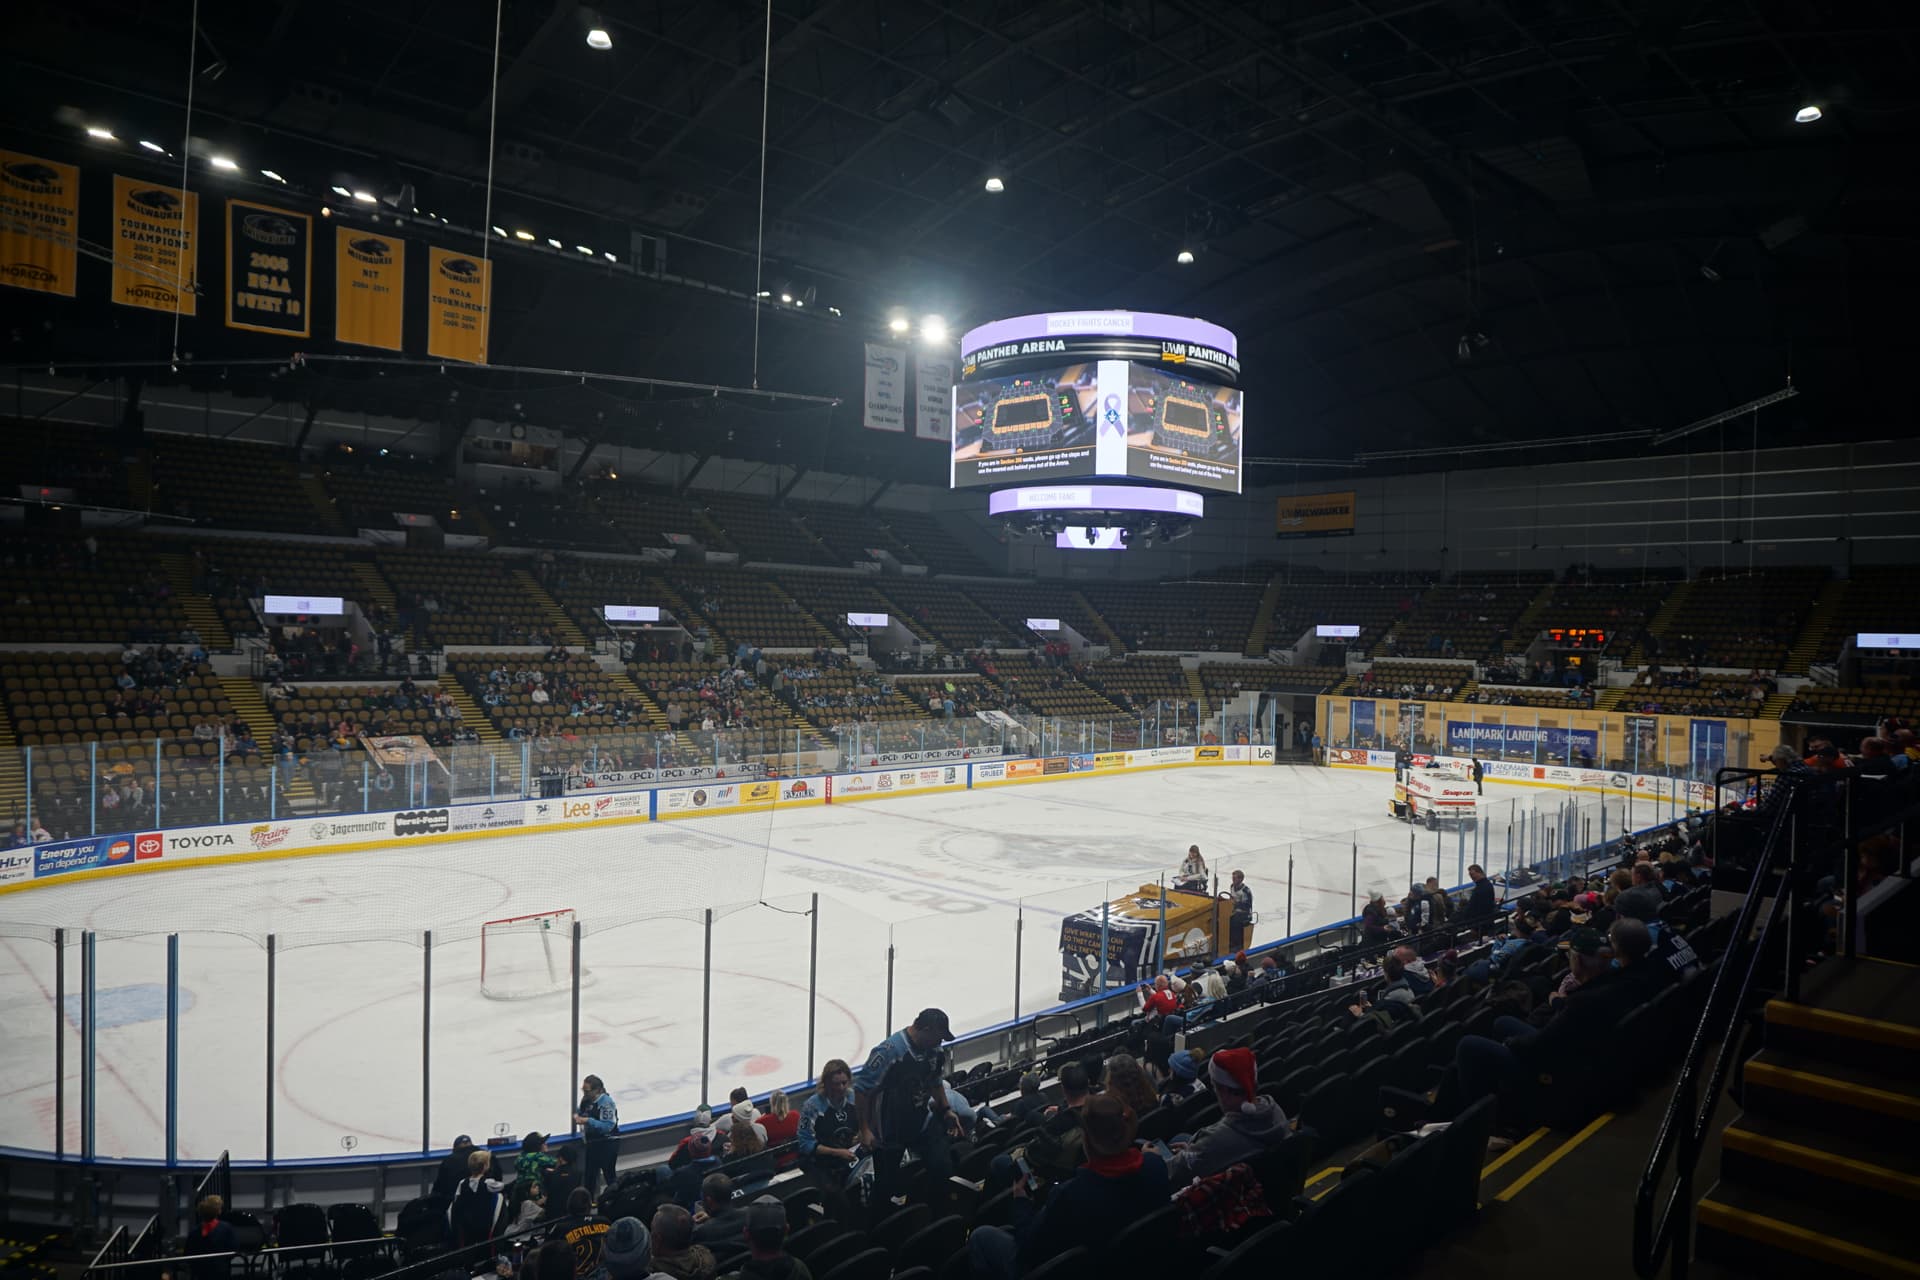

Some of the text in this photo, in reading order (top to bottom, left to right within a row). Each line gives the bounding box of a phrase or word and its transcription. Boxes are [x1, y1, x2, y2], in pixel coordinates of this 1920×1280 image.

[120, 218, 190, 239] TOURNAMENT
[121, 229, 189, 250] CHAMPIONS
[347, 248, 392, 264] MILWAUKEE
[0, 264, 58, 283] HORIZON
[362, 268, 379, 280] NIT
[248, 272, 292, 294] NCAA
[126, 286, 178, 304] HORIZON
[448, 287, 472, 299] NCAA
[236, 290, 282, 313] SWEET
[432, 295, 487, 313] TOURNAMENT
[1050, 319, 1075, 329] HOCKEY
[1103, 318, 1130, 328] CANCER
[977, 344, 1019, 364] PANTHER
[1022, 340, 1066, 354] ARENA
[1162, 341, 1186, 356] UWM
[1188, 345, 1227, 366] PANTHER
[1029, 492, 1076, 502] WELCOME FANS
[1452, 728, 1548, 742] LANDMARK LANDING
[1258, 748, 1272, 759] Le
[980, 769, 1003, 778] GRUBER
[1410, 776, 1430, 792] Snap-on
[563, 802, 590, 818] Lee
[489, 819, 523, 828] MEMORIES
[170, 834, 234, 849] TOYOTA
[40, 845, 95, 860] Energy you
[39, 862, 53, 870] can
[55, 857, 86, 868] depend
